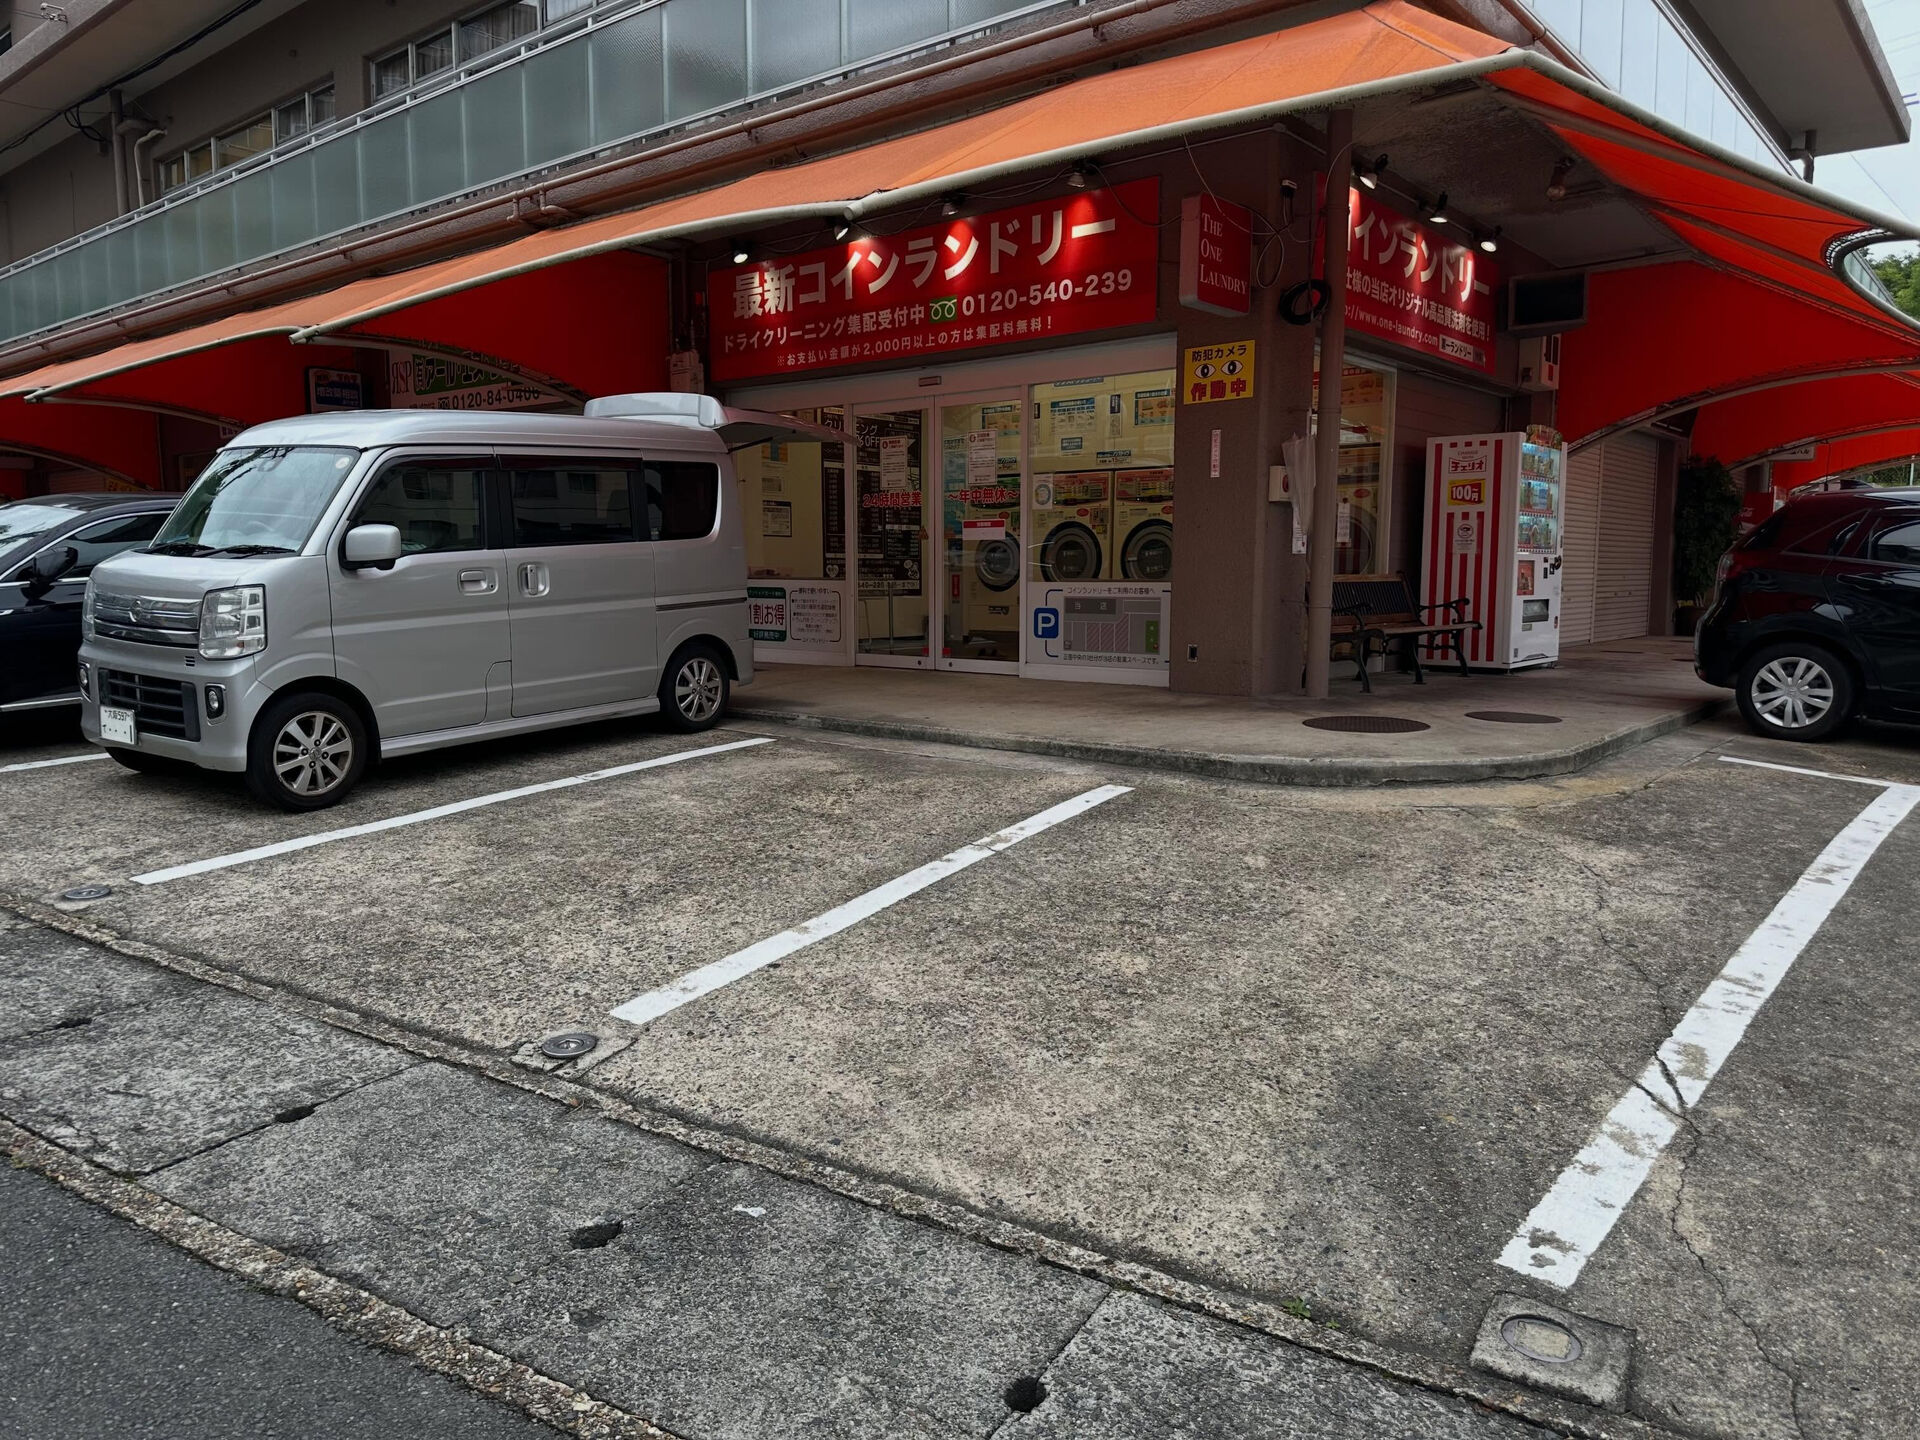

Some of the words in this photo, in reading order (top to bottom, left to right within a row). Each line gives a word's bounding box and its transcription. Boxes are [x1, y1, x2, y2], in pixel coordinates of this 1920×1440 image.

[1201, 212, 1223, 237] THE
[1201, 238, 1222, 262] ONE
[1348, 210, 1491, 303] インランドリー
[733, 209, 1117, 320] 最新コインランドリー
[1200, 263, 1248, 295] LAUNDRY
[723, 305, 926, 354] ドライクリーニング集配受付中
[961, 268, 1133, 317] 0120-540-239
[1191, 344, 1247, 363] 防犯カメラ
[1190, 378, 1247, 402] 作動中
[1452, 460, 1484, 471] チェリオ
[862, 491, 922, 508] 24時間営業
[1037, 613, 1056, 636] P
